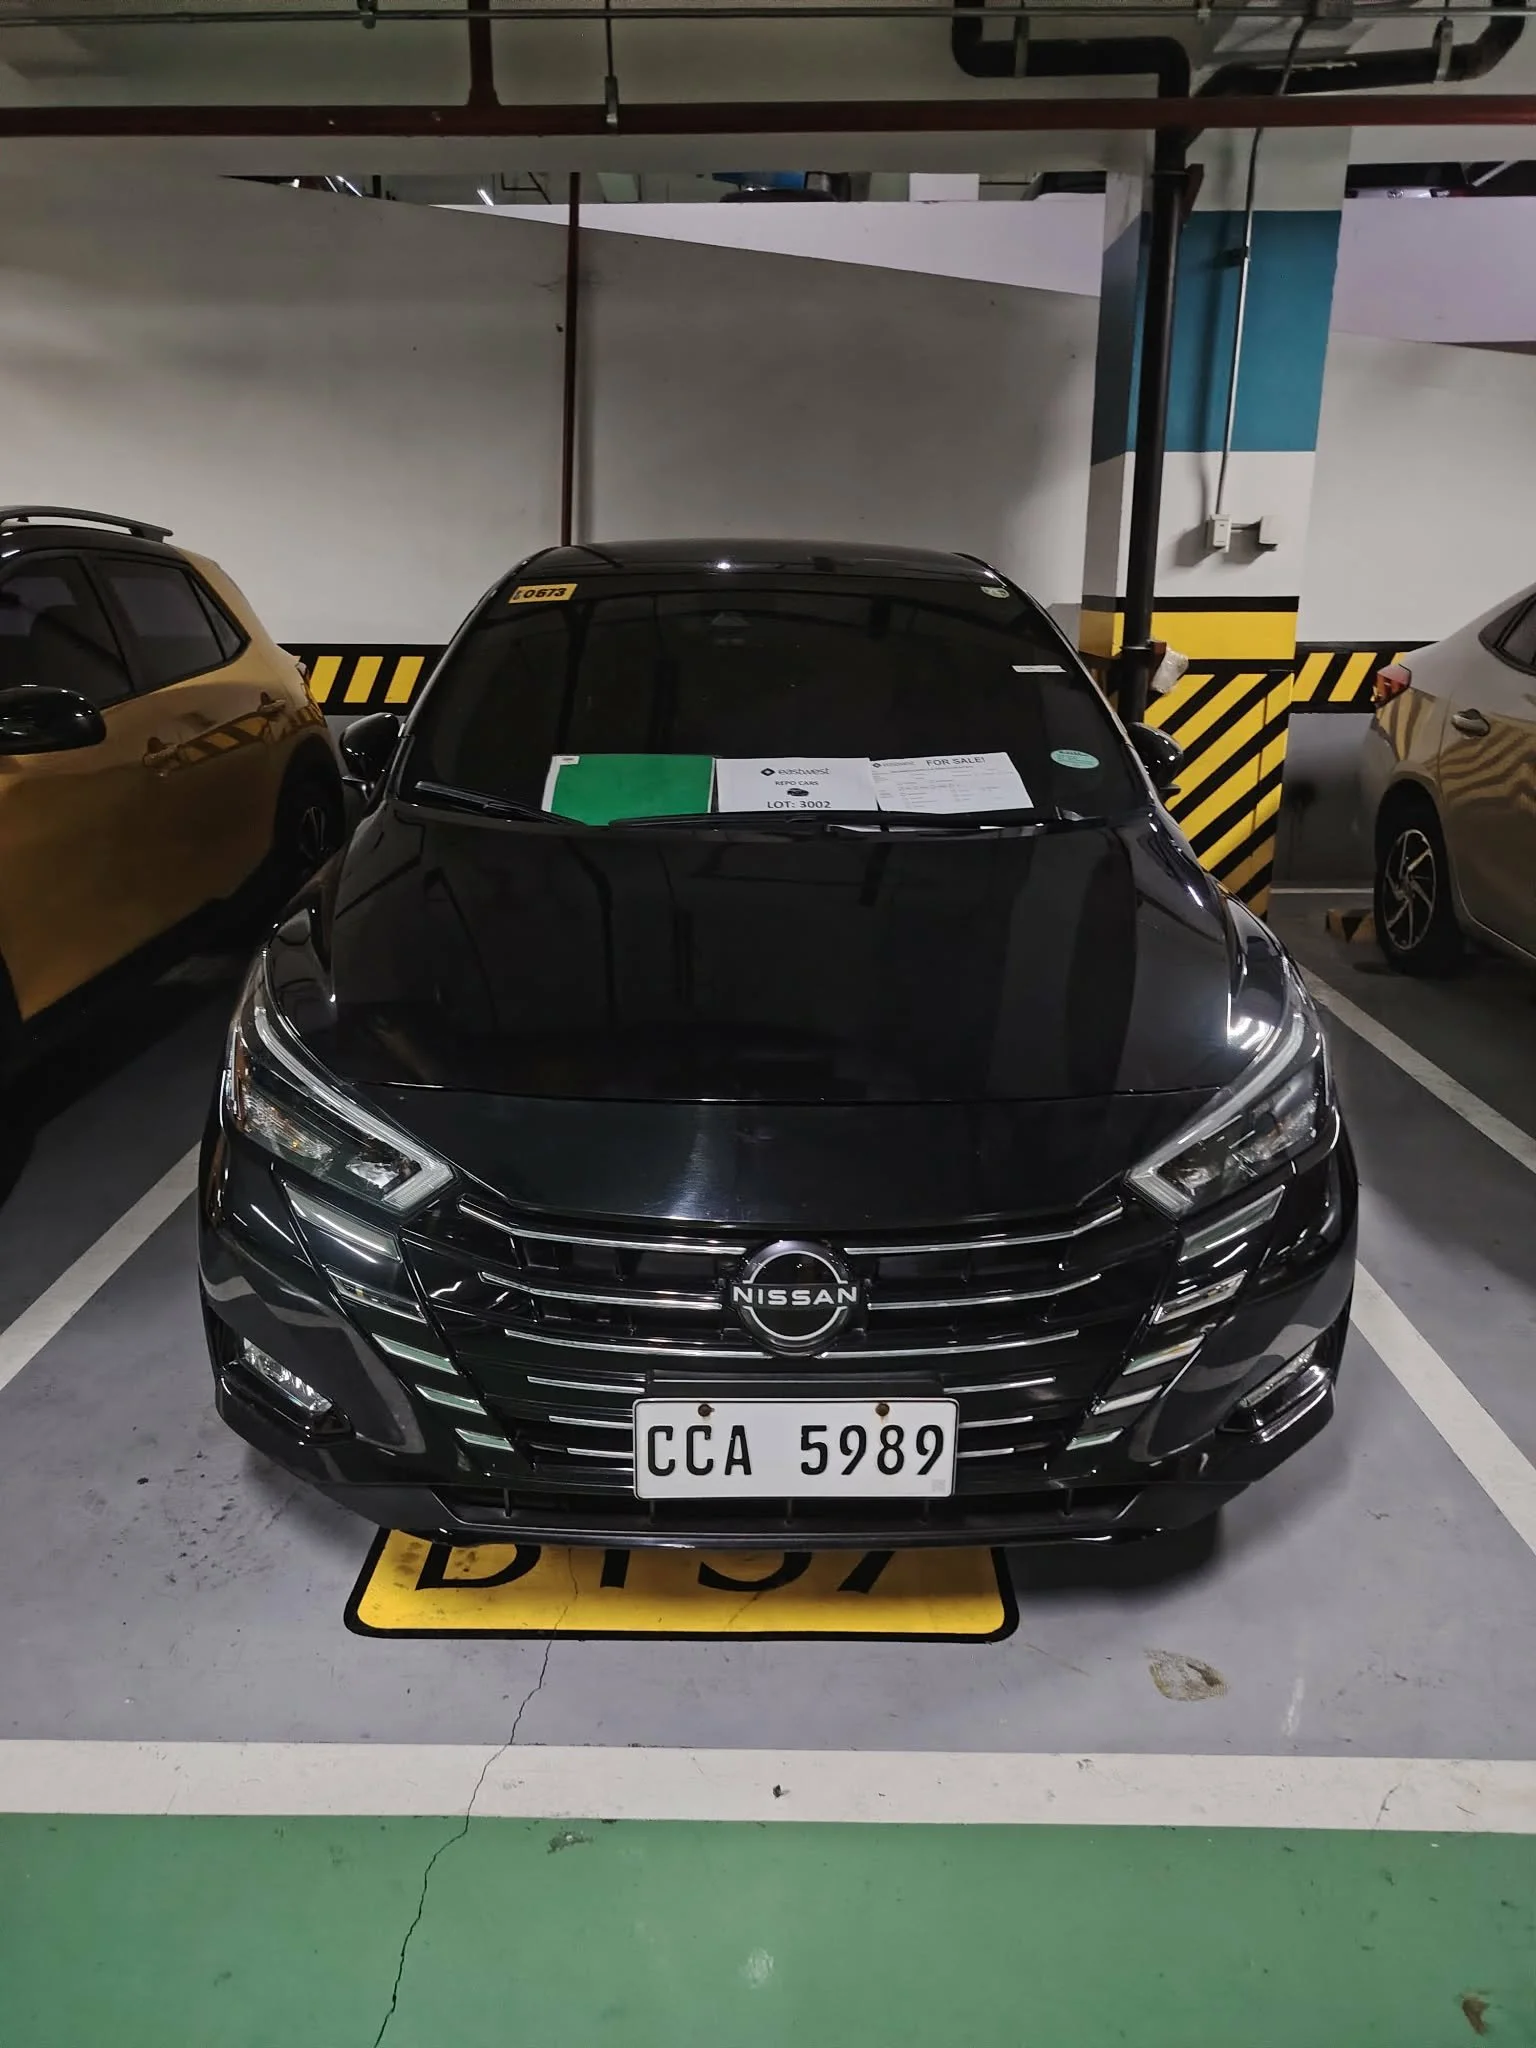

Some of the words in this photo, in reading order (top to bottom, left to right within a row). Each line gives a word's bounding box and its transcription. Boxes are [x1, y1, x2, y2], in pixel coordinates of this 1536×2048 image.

[952, 756, 986, 764] SALE!
[767, 800, 796, 809] LOT:
[799, 800, 832, 809] 3002
[732, 1285, 858, 1306] NISSAN
[647, 1424, 752, 1477] CCA
[800, 1424, 945, 1477] 5989
